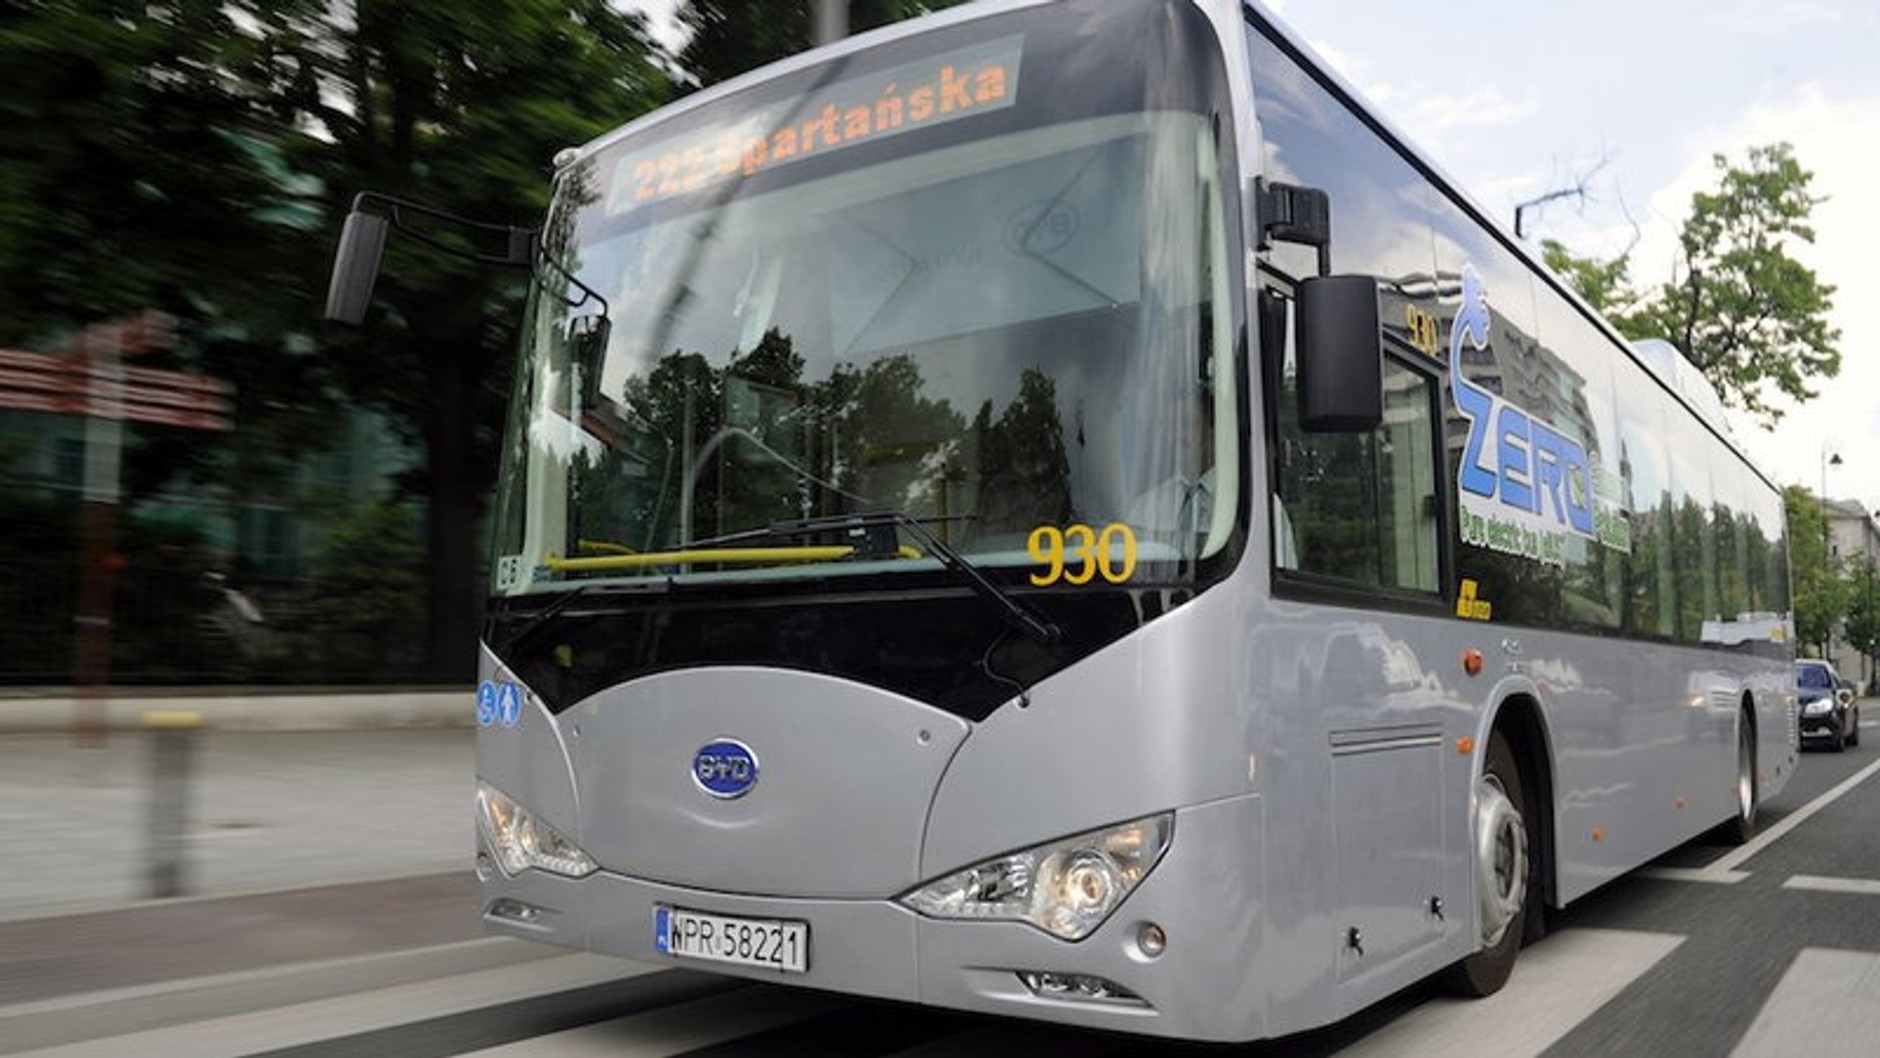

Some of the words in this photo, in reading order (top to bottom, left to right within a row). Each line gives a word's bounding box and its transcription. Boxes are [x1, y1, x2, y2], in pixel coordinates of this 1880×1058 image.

[1404, 302, 1438, 357] 930
[1454, 384, 1594, 534] ZERO
[1027, 522, 1137, 586] 930
[699, 754, 750, 780] BYD
[723, 923, 797, 966] 58221
